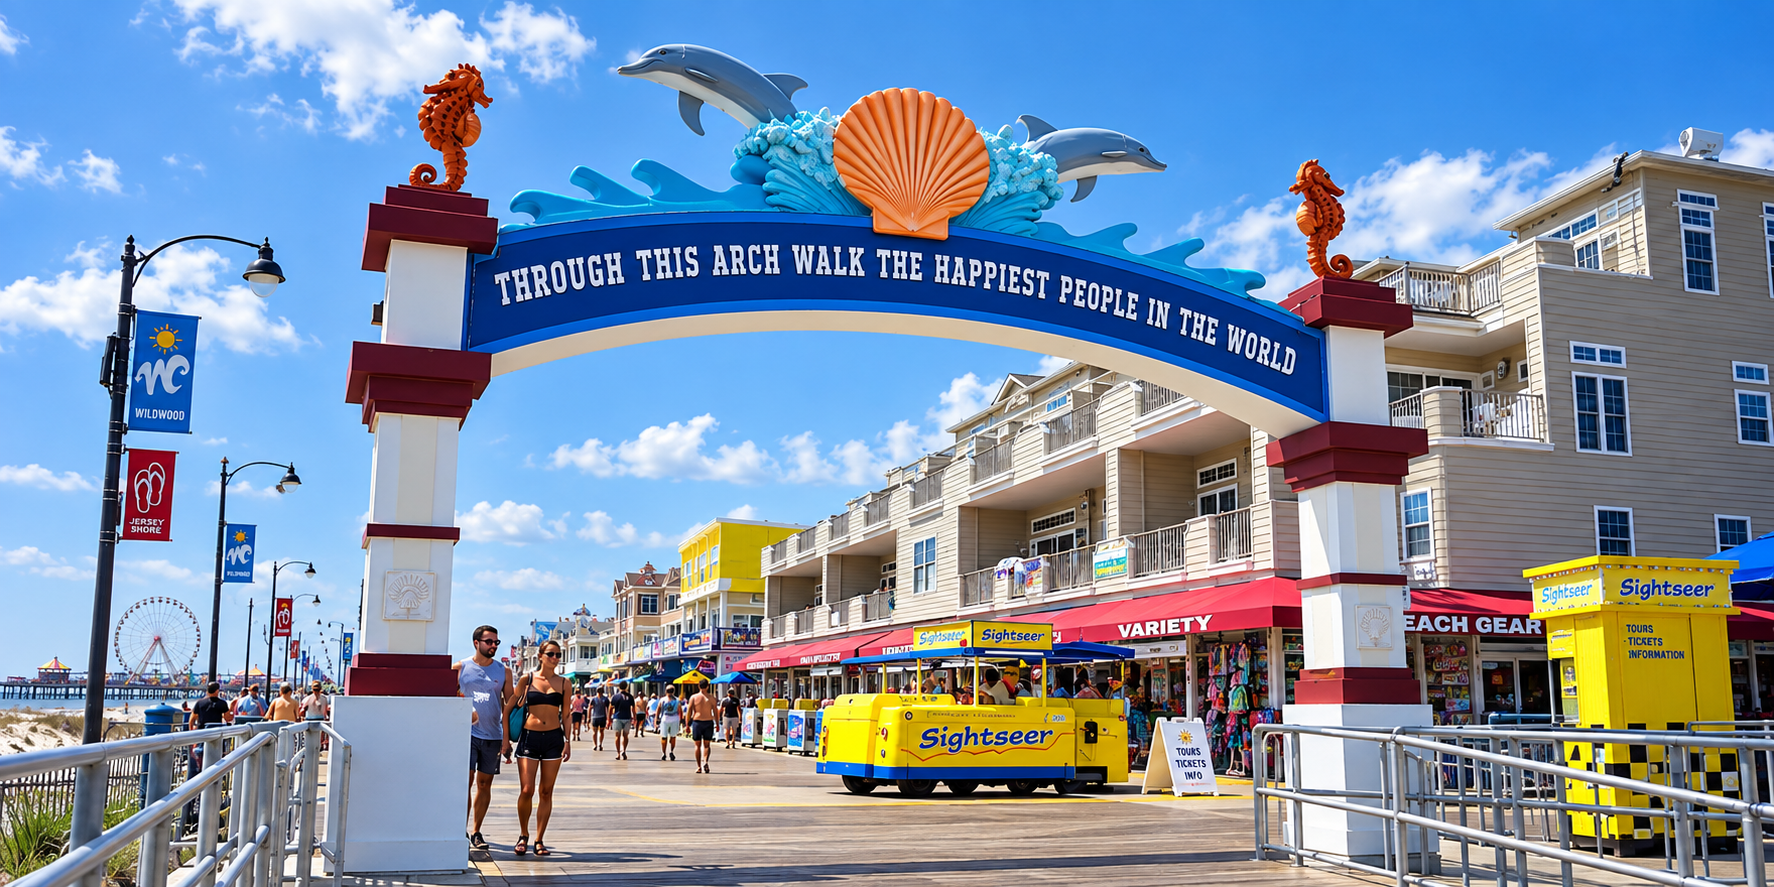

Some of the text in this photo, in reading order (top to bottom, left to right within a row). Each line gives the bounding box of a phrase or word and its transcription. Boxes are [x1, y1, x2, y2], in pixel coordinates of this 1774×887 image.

[494, 244, 1298, 377] THROUGH THIS ARCH WALK THE HAPPIEST PEOPLE IN THE WORLD
[135, 407, 185, 421] WILDWOOD
[129, 517, 165, 526] JERSEY
[130, 525, 162, 534] SHORE
[1541, 583, 1593, 605] Sightseer
[1619, 578, 1715, 601] Sightseer
[1117, 614, 1213, 639] VARIETY
[1403, 614, 1542, 635] EACH GEAR
[1626, 624, 1654, 634] TOURS
[981, 629, 1045, 644] Sightseer
[1627, 637, 1663, 647] TICKETS
[1628, 650, 1685, 660] INFORMATION
[919, 726, 1053, 753] Sightseer
[1175, 747, 1202, 756] TOURS
